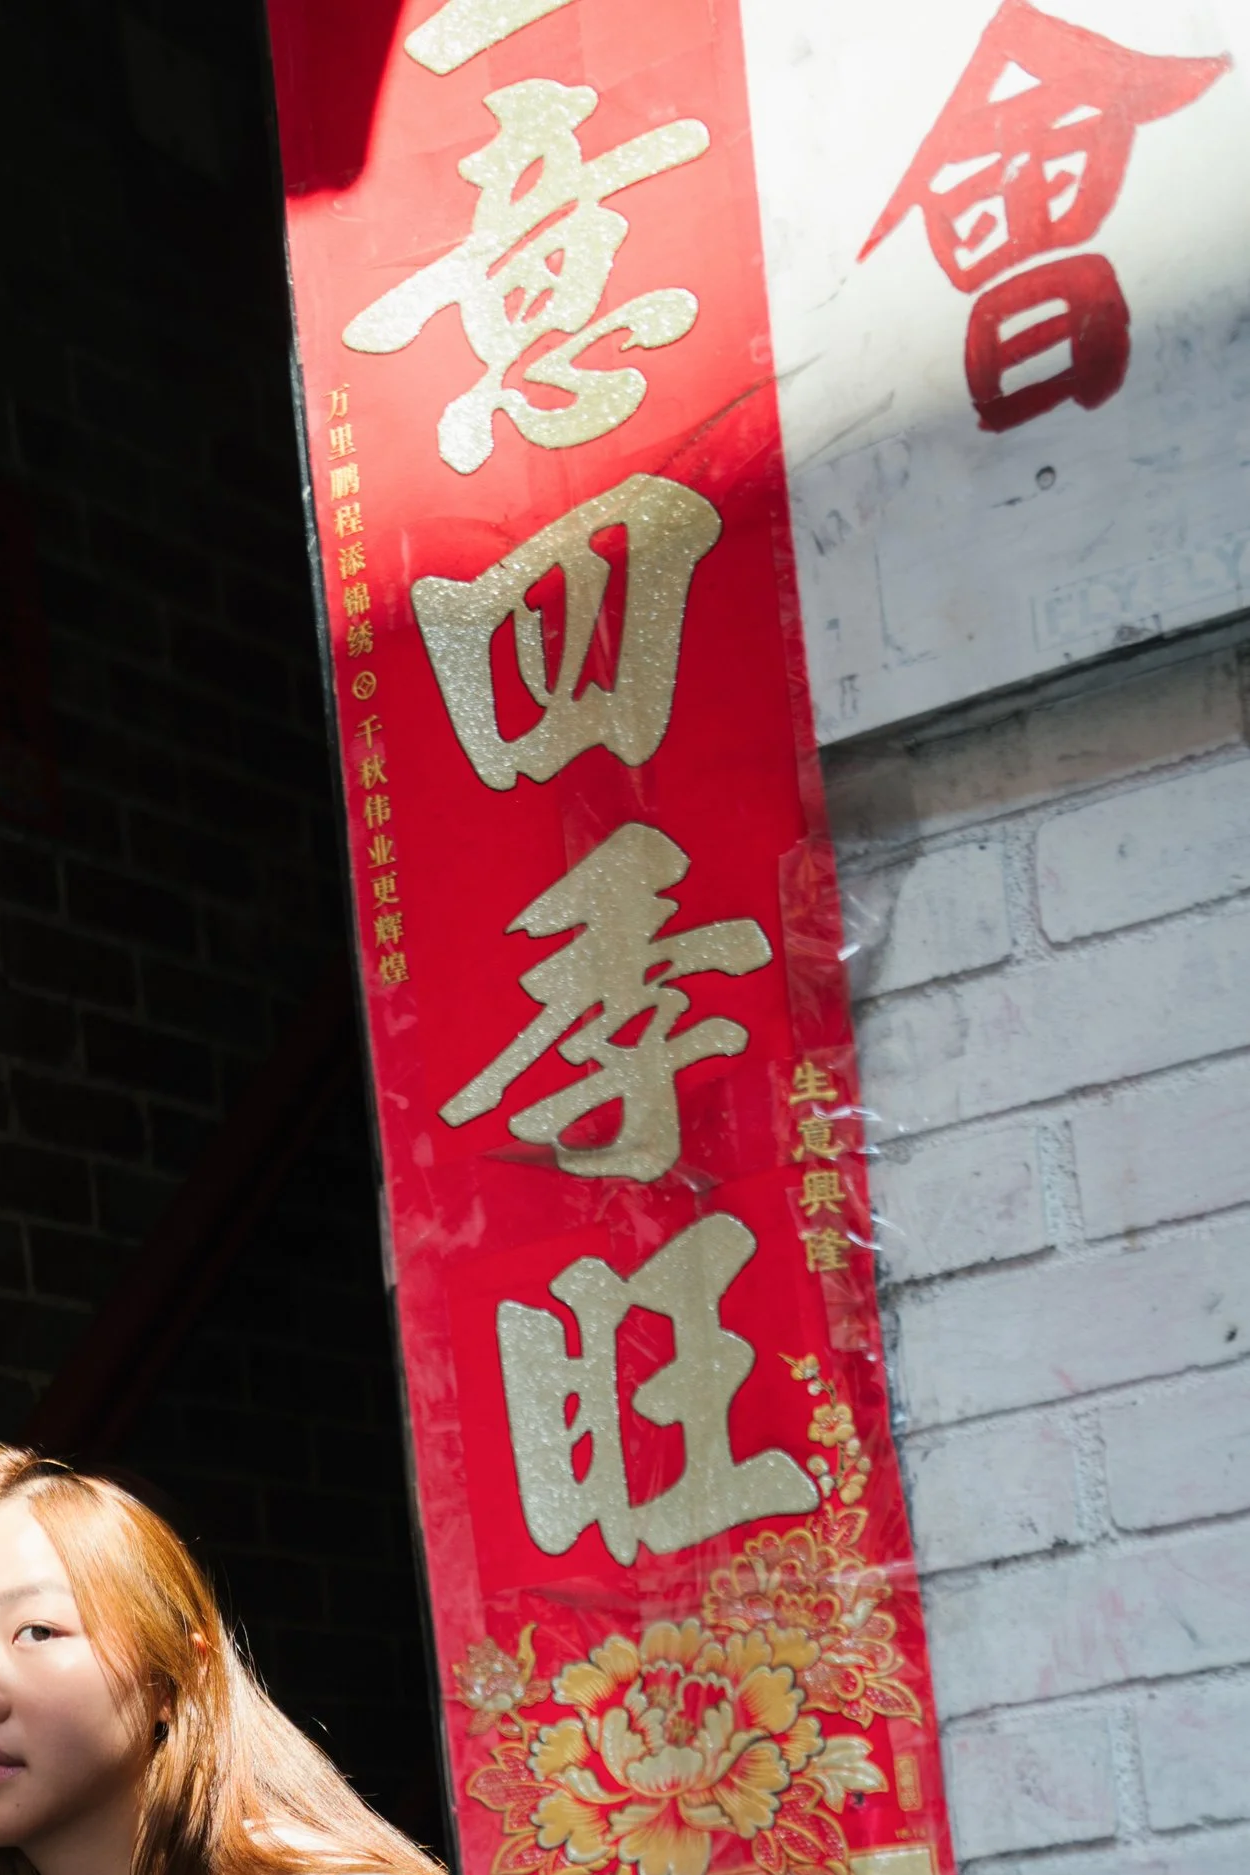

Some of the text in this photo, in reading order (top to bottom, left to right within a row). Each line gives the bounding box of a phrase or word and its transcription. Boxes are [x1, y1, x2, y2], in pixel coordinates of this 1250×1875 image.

[857, 0, 1233, 433] 會
[321, 383, 410, 987] 万里鹏程添锦绣 千秋伟业更辉煌
[342, 0, 820, 1567] 意四季旺
[789, 1061, 851, 1274] 生意興隆
